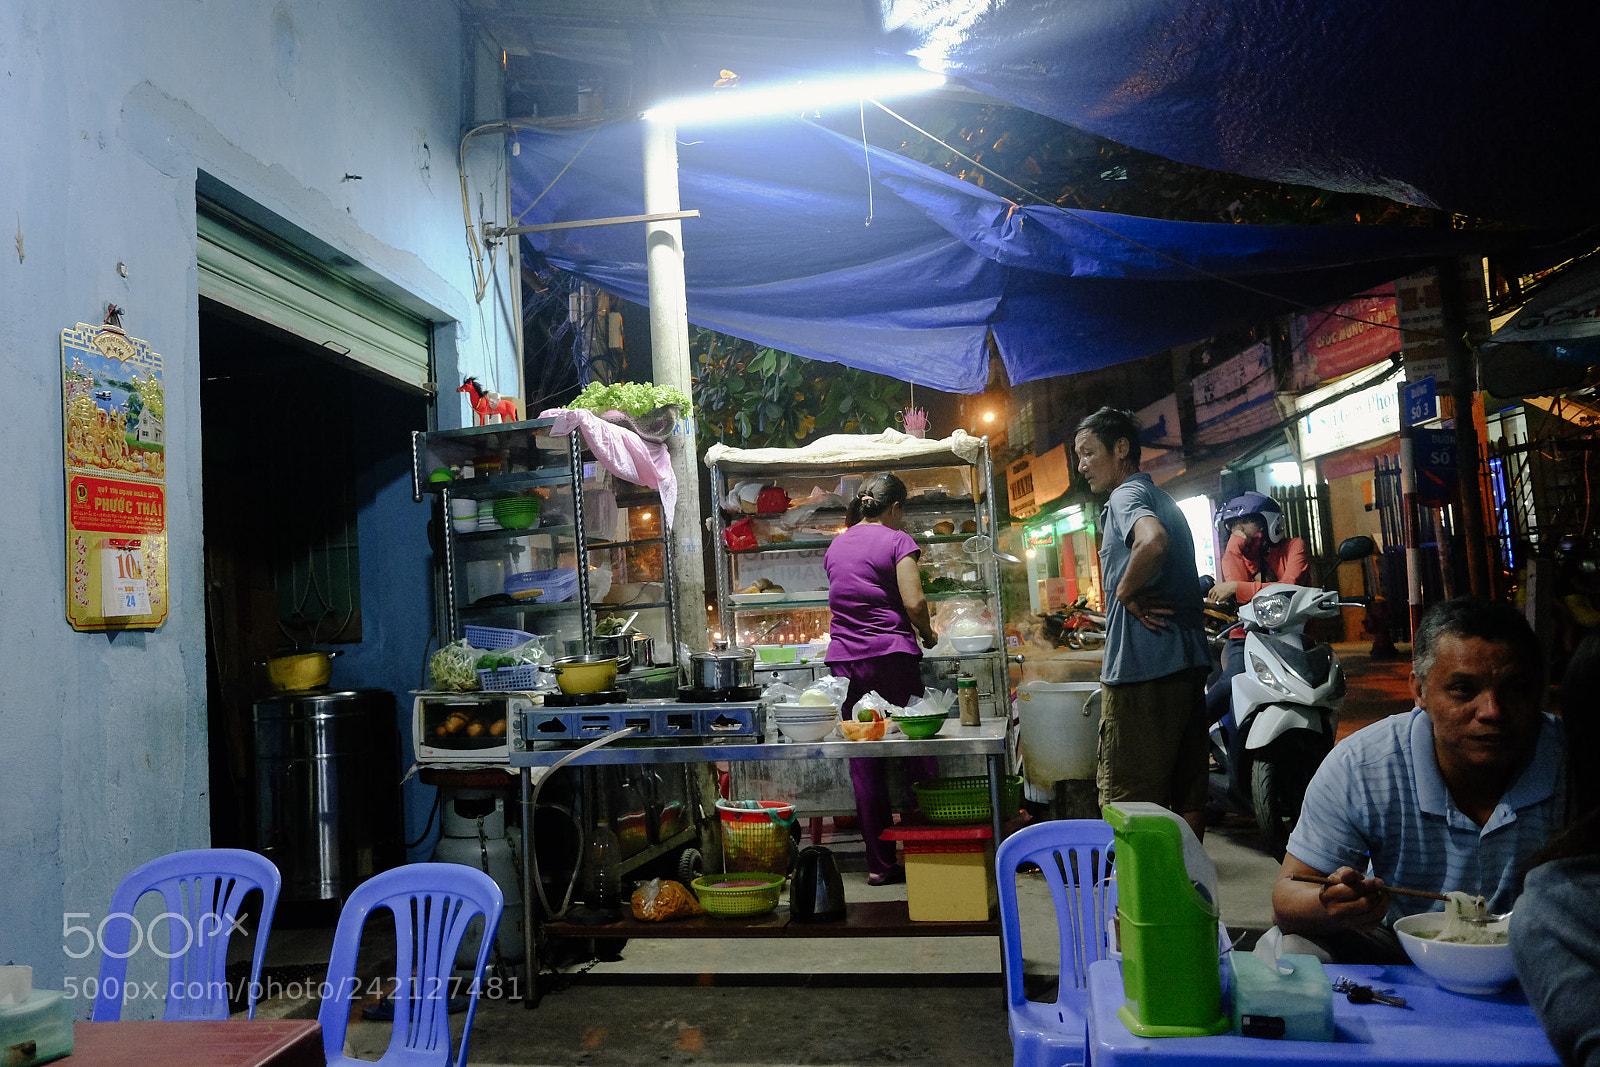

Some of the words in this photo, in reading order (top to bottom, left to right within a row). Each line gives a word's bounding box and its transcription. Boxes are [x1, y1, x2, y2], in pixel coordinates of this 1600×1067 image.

[1423, 402, 1429, 416] 3
[94, 497, 133, 513] PHƯỚC
[136, 501, 162, 516] THÁI
[115, 554, 136, 579] 10
[126, 595, 136, 607] 24
